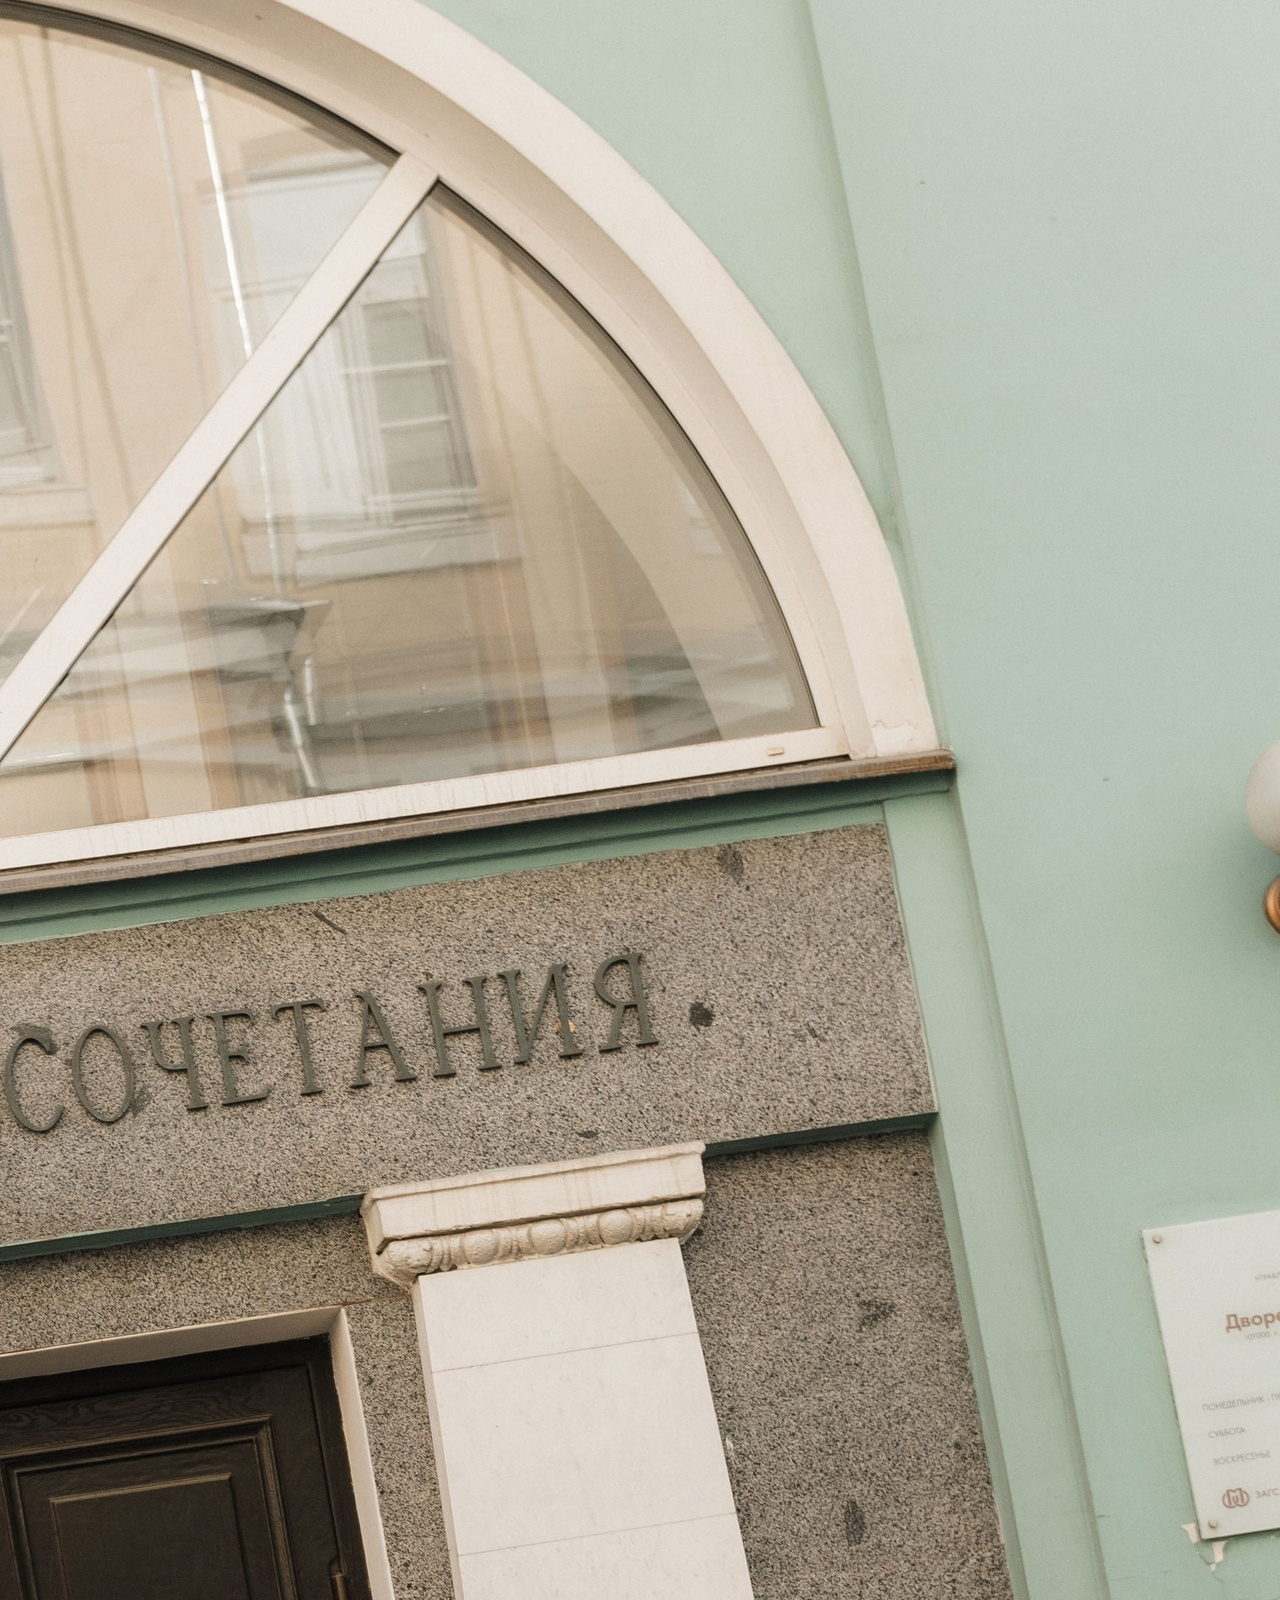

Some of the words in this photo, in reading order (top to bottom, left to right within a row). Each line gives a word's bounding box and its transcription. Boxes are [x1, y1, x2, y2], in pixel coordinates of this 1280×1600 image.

[1202, 1396, 1264, 1412] ПОНЕДЕЛЬНИК
[1208, 1427, 1245, 1438] СУББОТА
[1213, 1450, 1271, 1465] ВОСКРЕСЕНЬЕ
